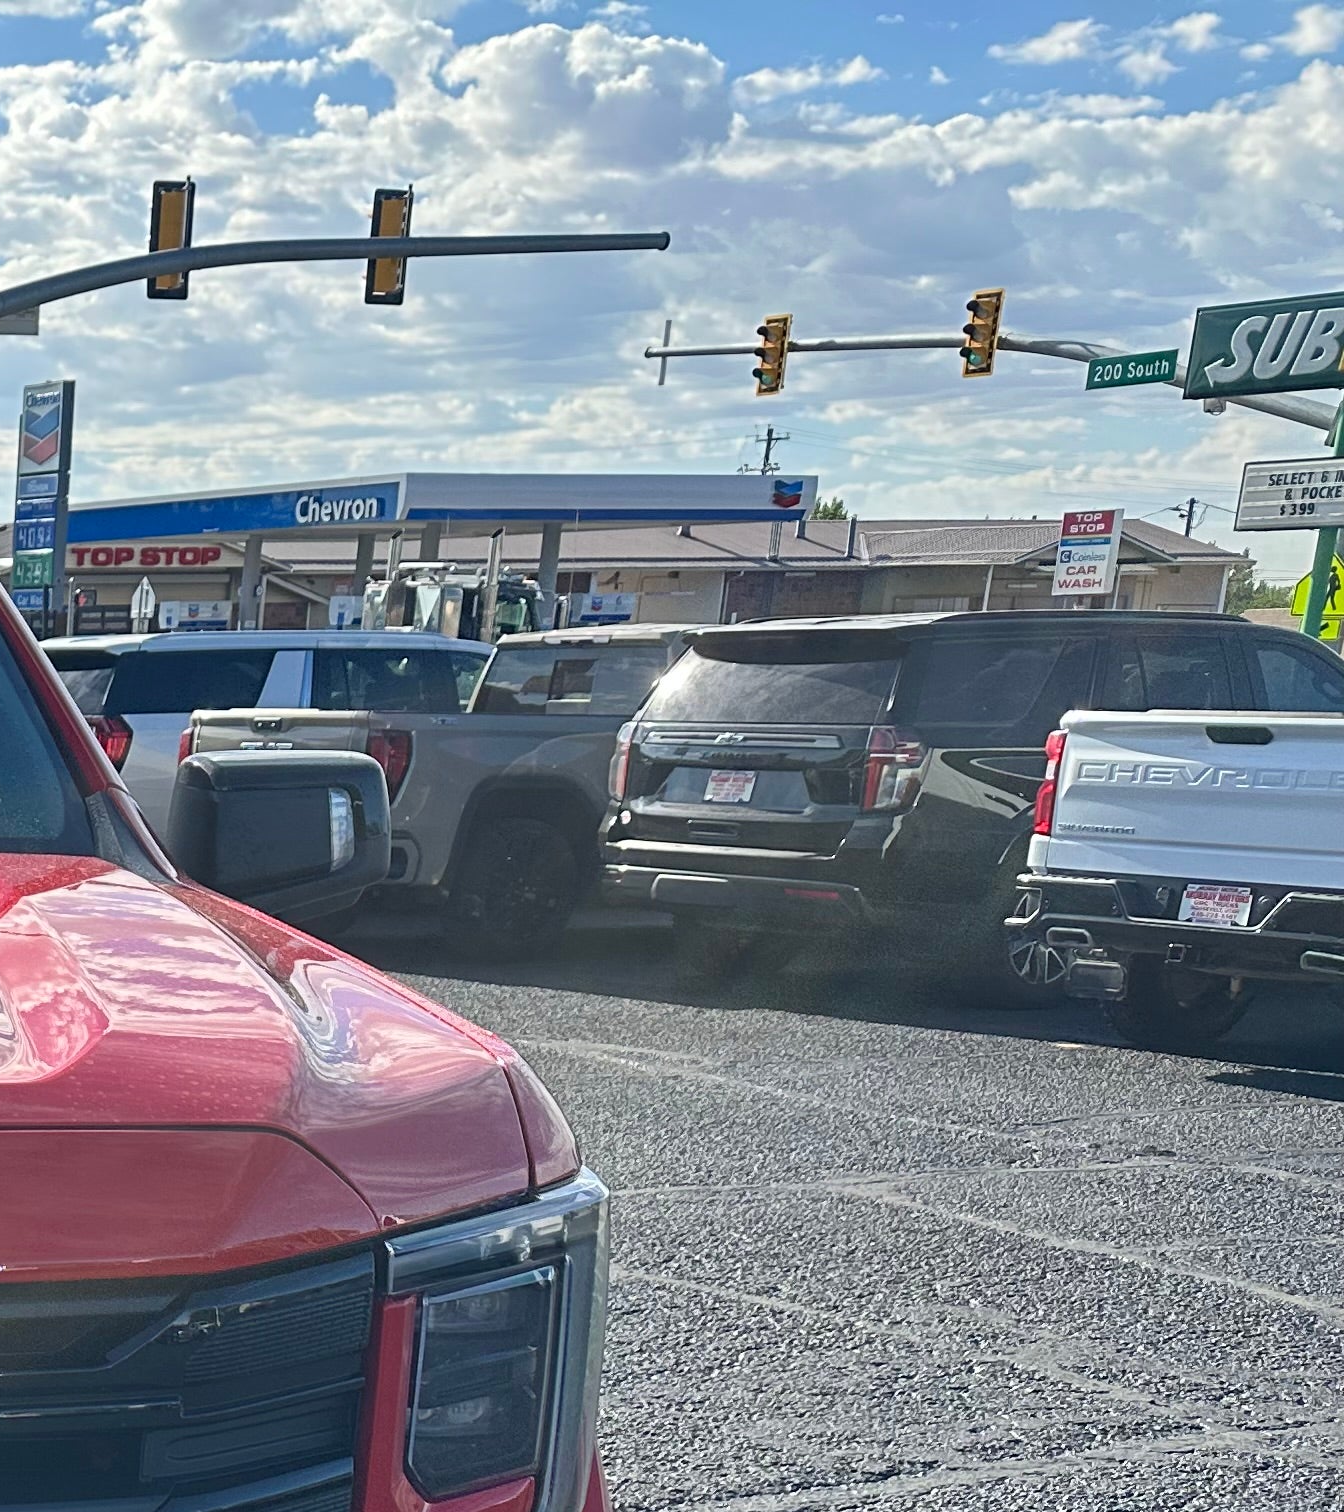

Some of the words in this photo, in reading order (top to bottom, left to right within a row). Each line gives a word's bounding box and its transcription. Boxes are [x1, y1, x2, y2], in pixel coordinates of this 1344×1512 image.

[1203, 306, 1344, 388] SUB
[1093, 363, 1123, 382] 200
[1127, 359, 1170, 379] South
[1268, 471, 1315, 487] SELECT
[1320, 470, 1329, 483] 6
[294, 495, 378, 524] Chevron
[1076, 512, 1104, 523] TOP
[1069, 523, 1106, 534] STOP
[71, 546, 135, 568] TOP
[139, 545, 222, 567] STOP
[1065, 565, 1098, 576] CAR
[1057, 577, 1103, 589] WASH
